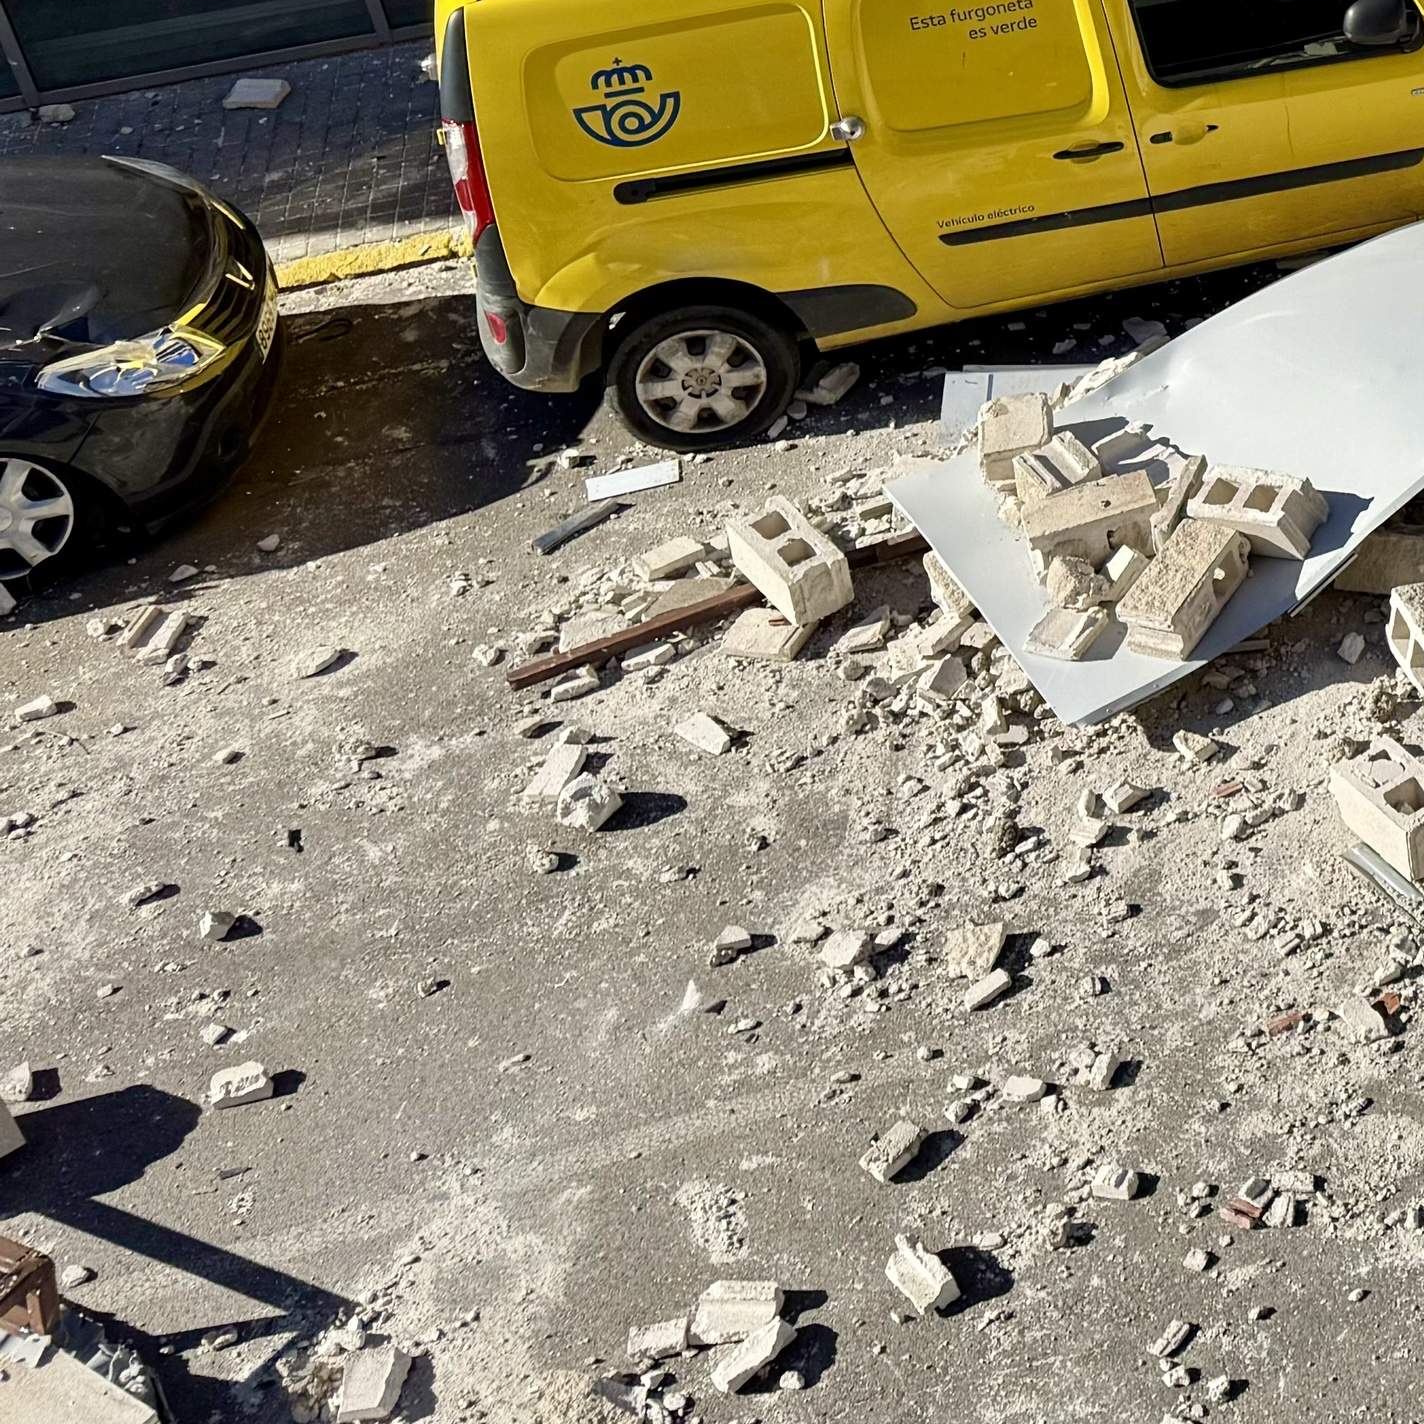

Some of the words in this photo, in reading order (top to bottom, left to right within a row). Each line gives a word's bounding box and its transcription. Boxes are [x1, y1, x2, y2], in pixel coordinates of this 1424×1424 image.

[909, 14, 947, 31] Esta
[968, 27, 988, 40] es
[990, 16, 1038, 36] verde
[936, 214, 985, 228] Vehículo
[987, 204, 1036, 220] eléctrico
